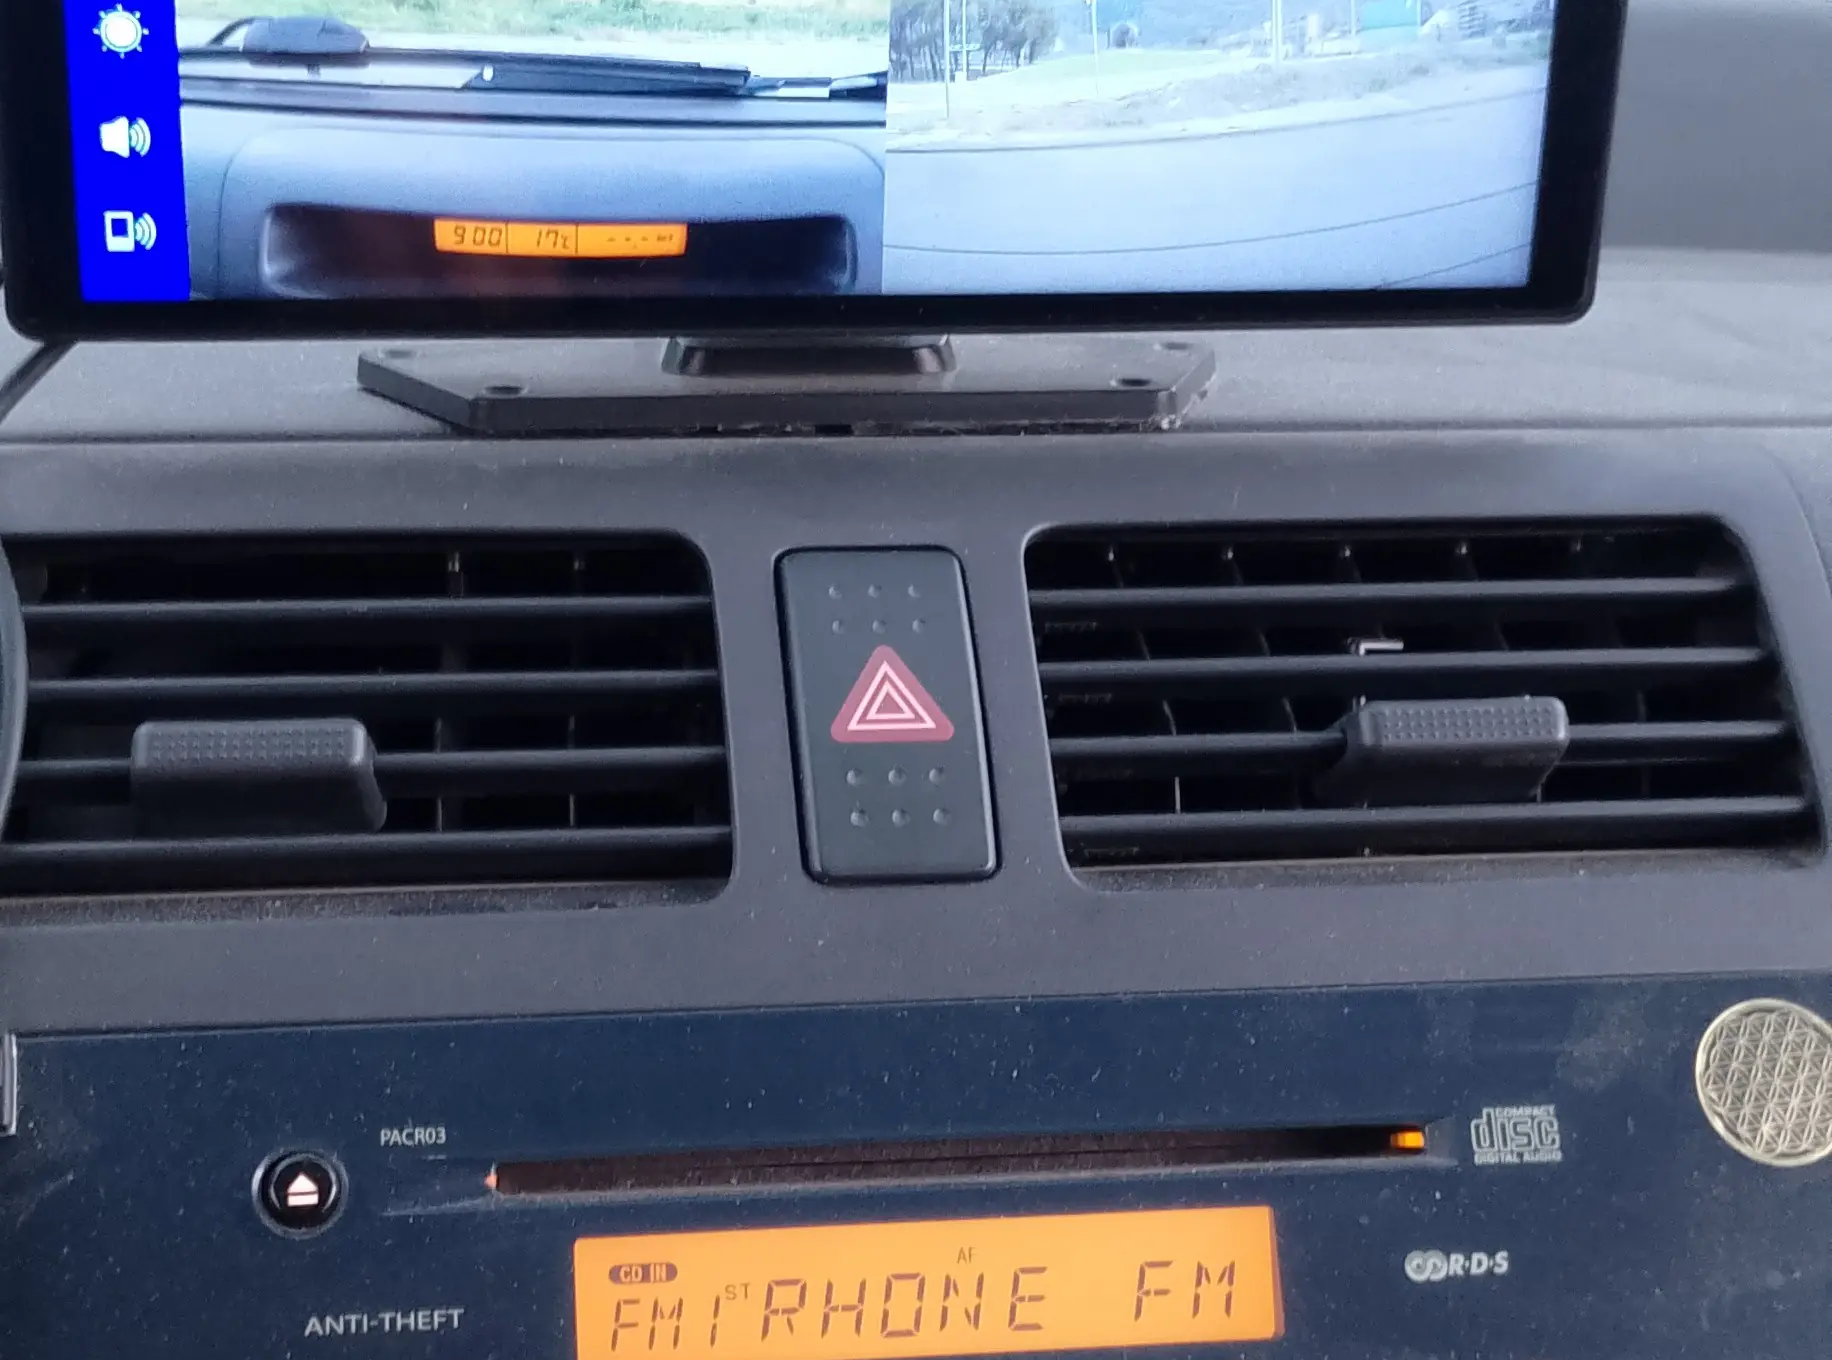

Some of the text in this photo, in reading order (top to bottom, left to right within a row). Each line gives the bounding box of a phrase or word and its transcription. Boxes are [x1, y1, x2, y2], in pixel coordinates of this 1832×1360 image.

[380, 1127, 447, 1146] PACR03
[1470, 1107, 1560, 1152] disc
[957, 1246, 977, 1264] AF
[618, 1262, 668, 1283] CD IN
[724, 1282, 751, 1301] ST
[760, 1259, 1237, 1343] RHONE FM
[304, 1307, 466, 1338] ANTI-THEFT
